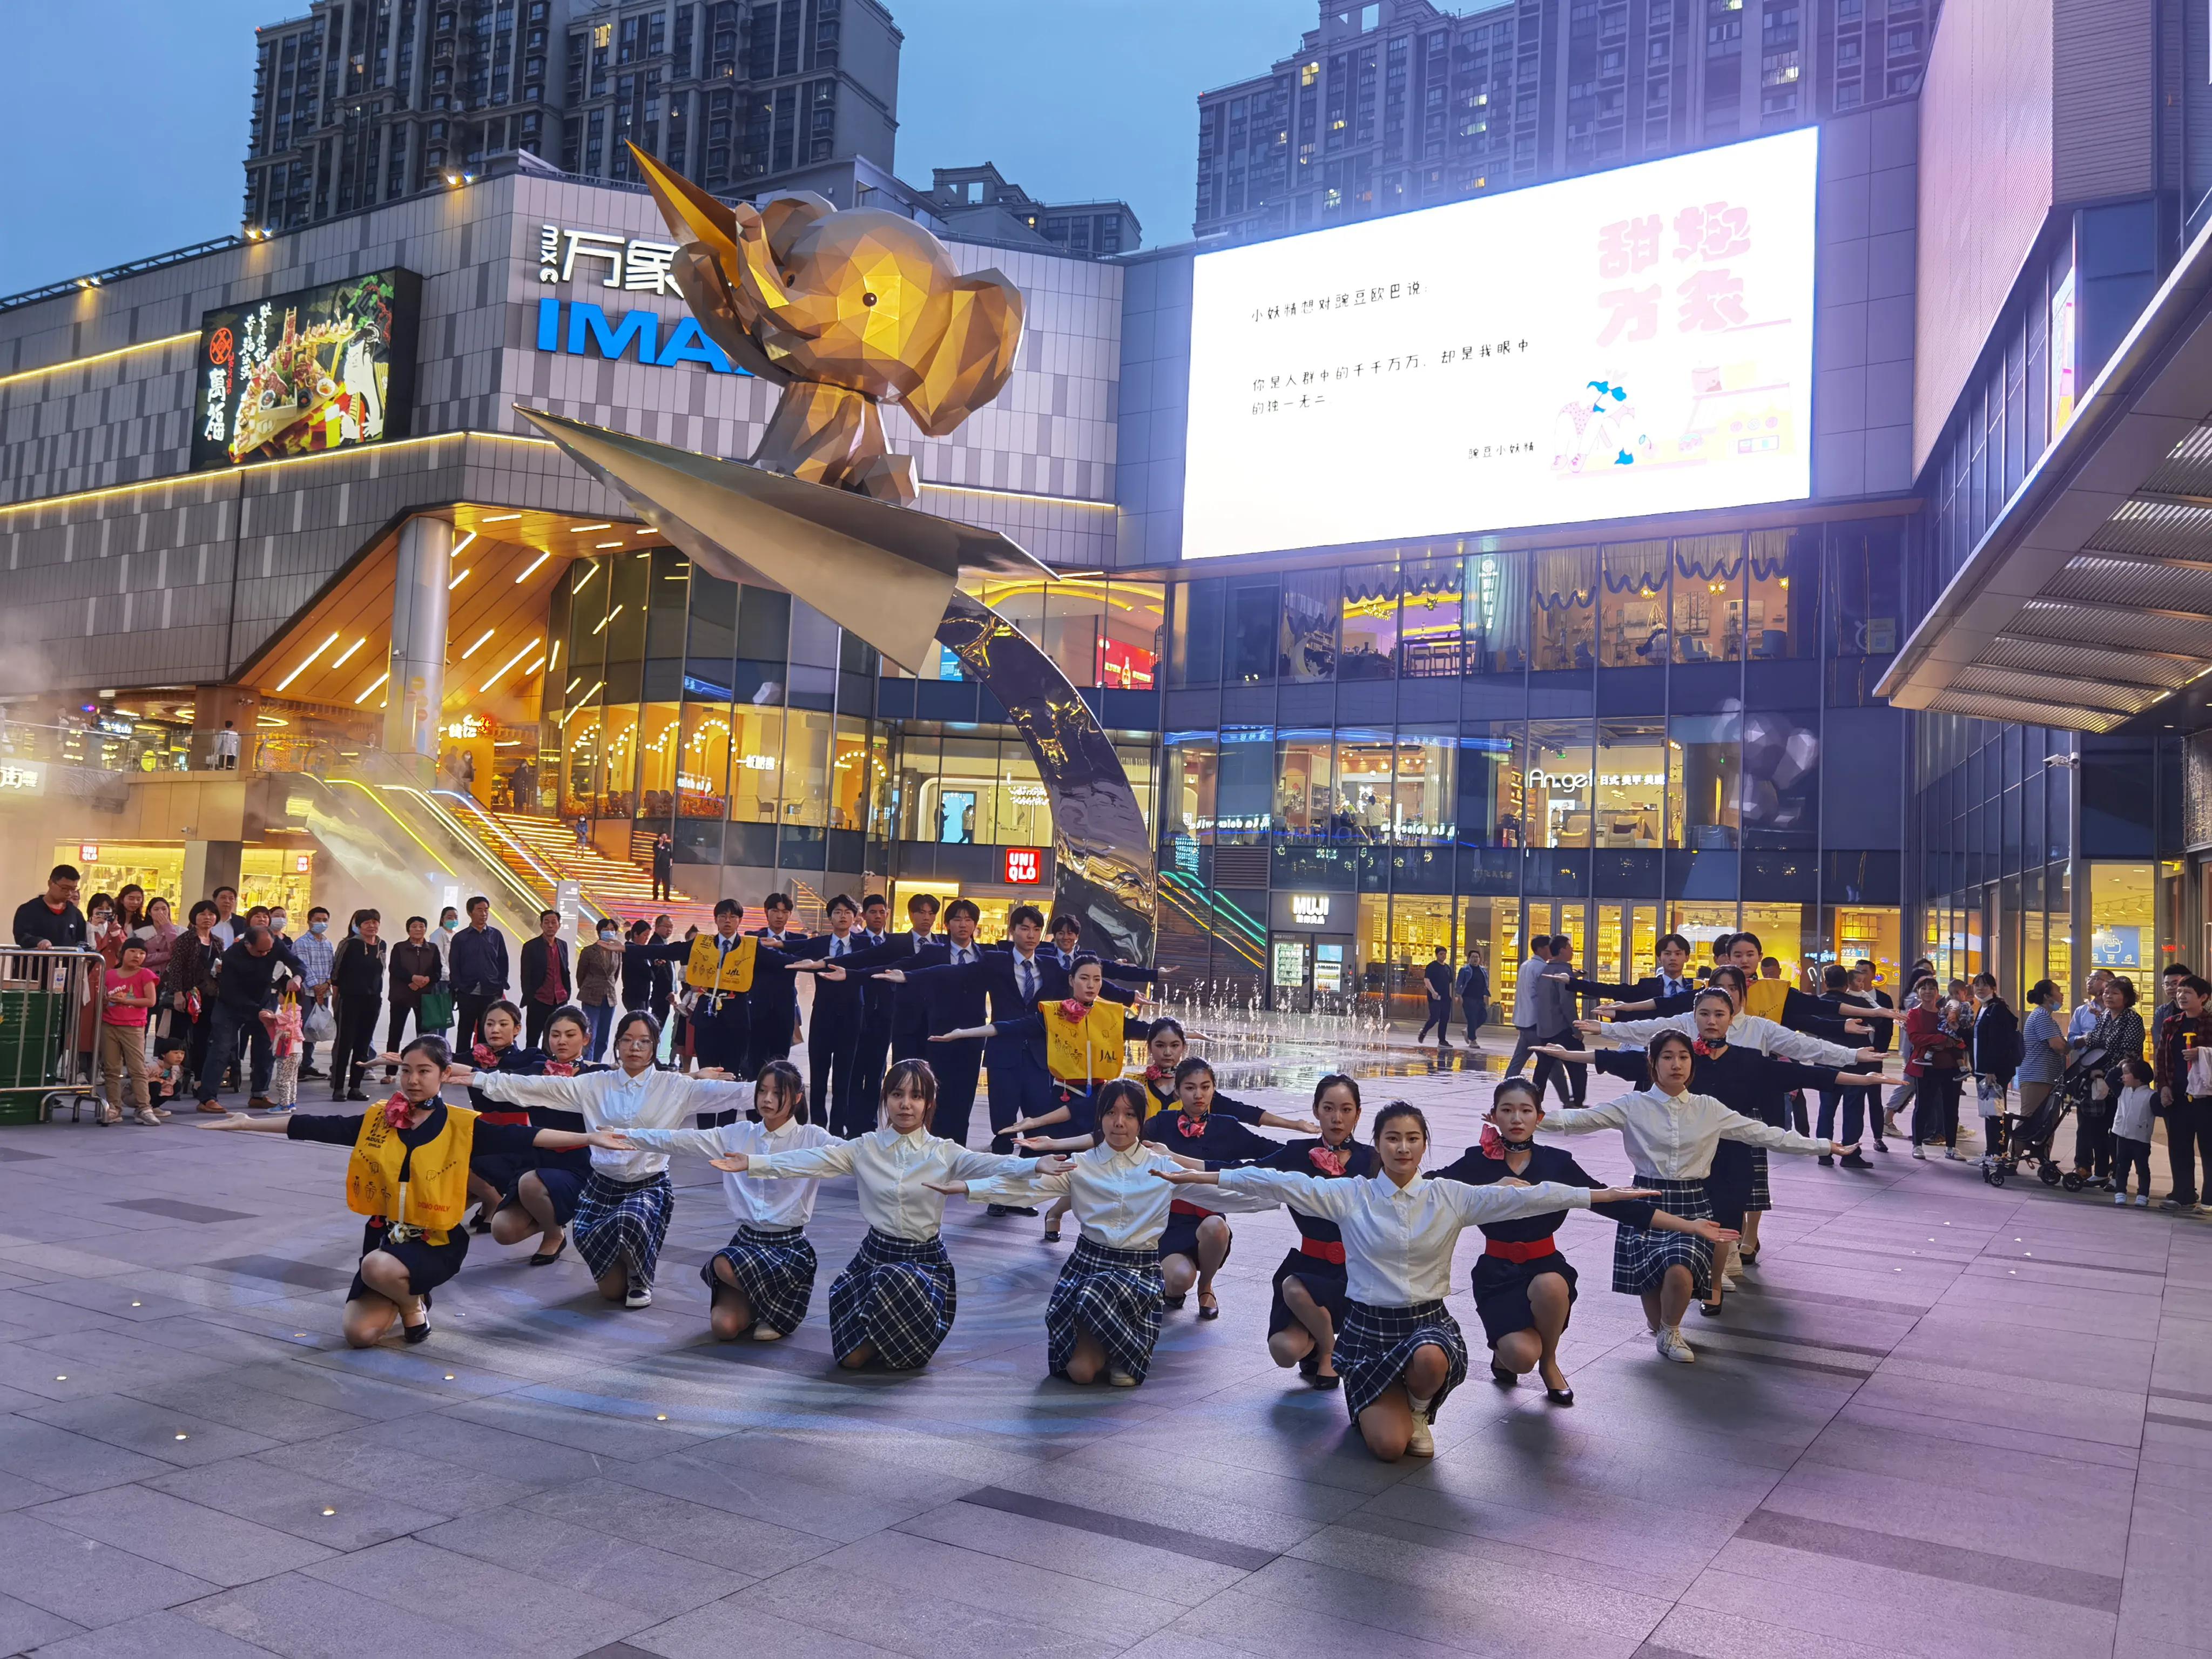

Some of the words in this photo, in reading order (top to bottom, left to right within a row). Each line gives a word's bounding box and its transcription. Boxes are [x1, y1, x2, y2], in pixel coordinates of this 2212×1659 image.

[538, 298, 754, 376] IMA
[1009, 852, 1034, 866] UNI
[1008, 866, 1036, 881] QLO
[1293, 896, 1329, 915] MUJI
[726, 968, 740, 976] JAL
[1099, 1049, 1116, 1062] JAL
[366, 1135, 386, 1144] ADULT
[433, 1204, 450, 1212] ONLY
